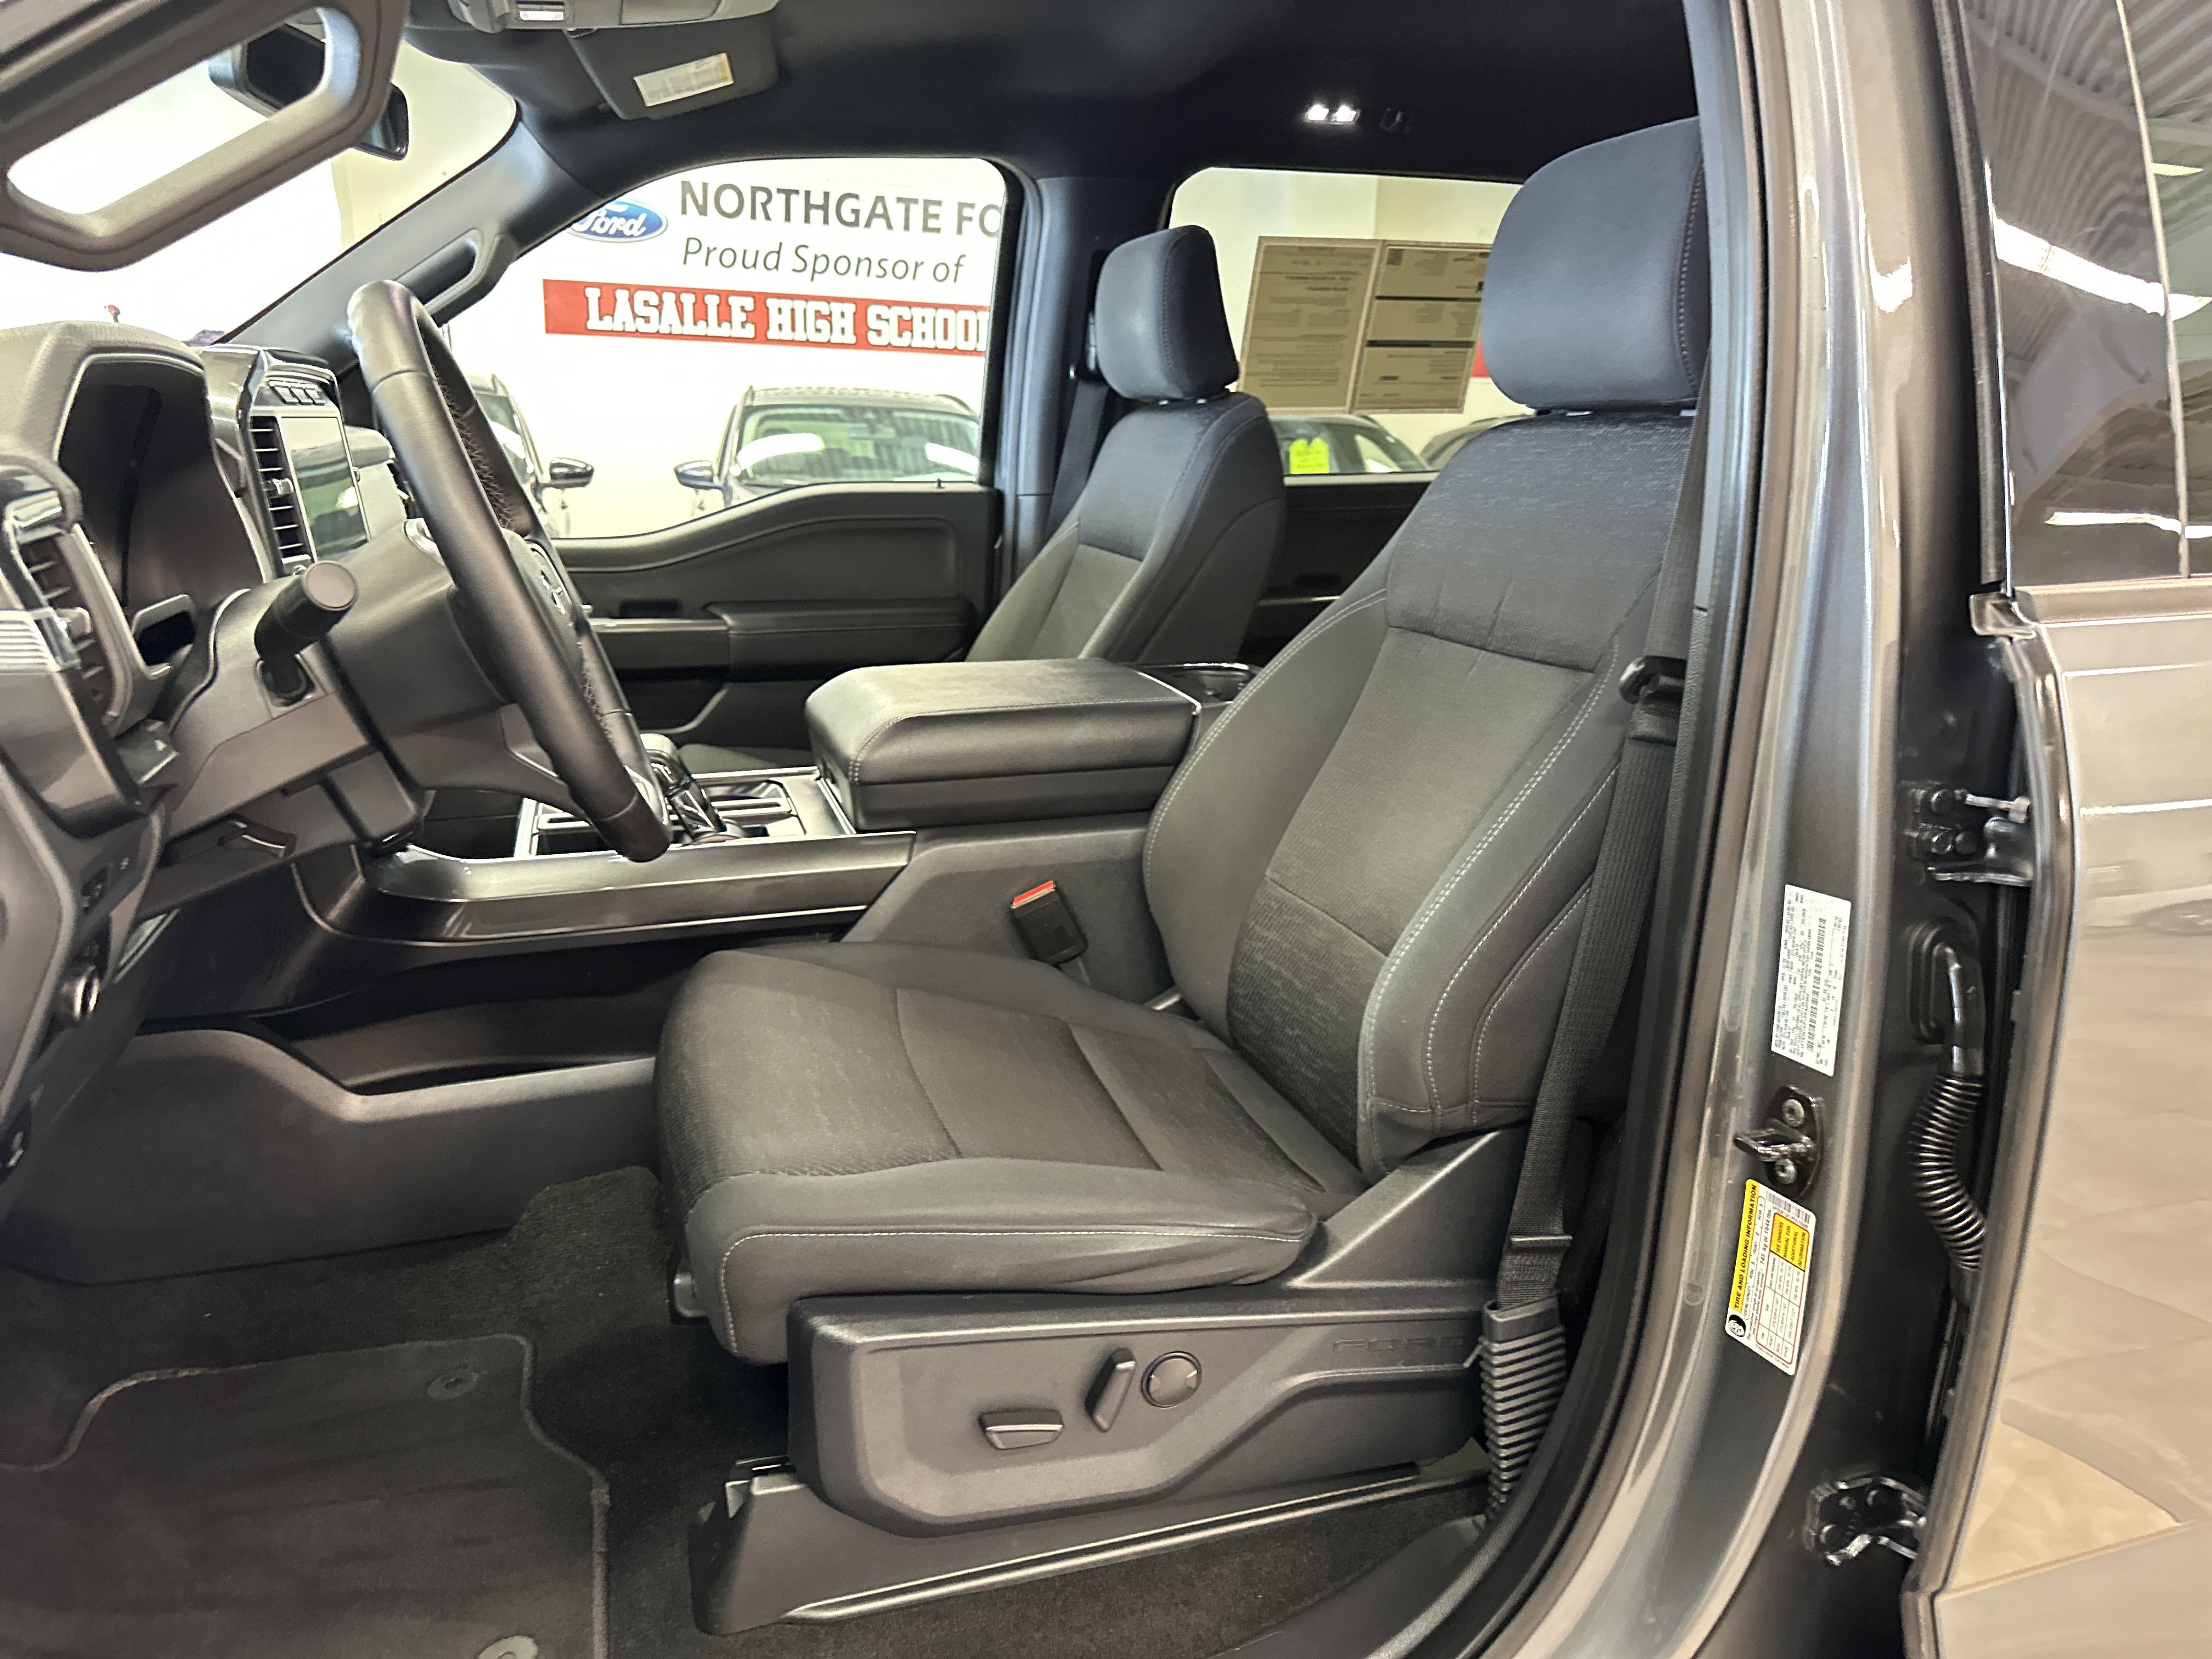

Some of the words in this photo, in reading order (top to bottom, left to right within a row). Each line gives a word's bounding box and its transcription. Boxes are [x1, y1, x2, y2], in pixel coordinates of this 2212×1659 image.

[571, 204, 647, 236] Ford
[680, 179, 942, 234] NORTHGATE
[683, 238, 782, 273] Proud
[792, 244, 925, 283] Sponsor
[933, 254, 966, 284] of
[584, 287, 756, 340] LASALLE
[766, 299, 856, 345] HIGH
[1740, 1238, 1749, 1273] LOADING
[1746, 1184, 1757, 1238] INFORMATION
[1762, 1242, 1768, 1252] kg
